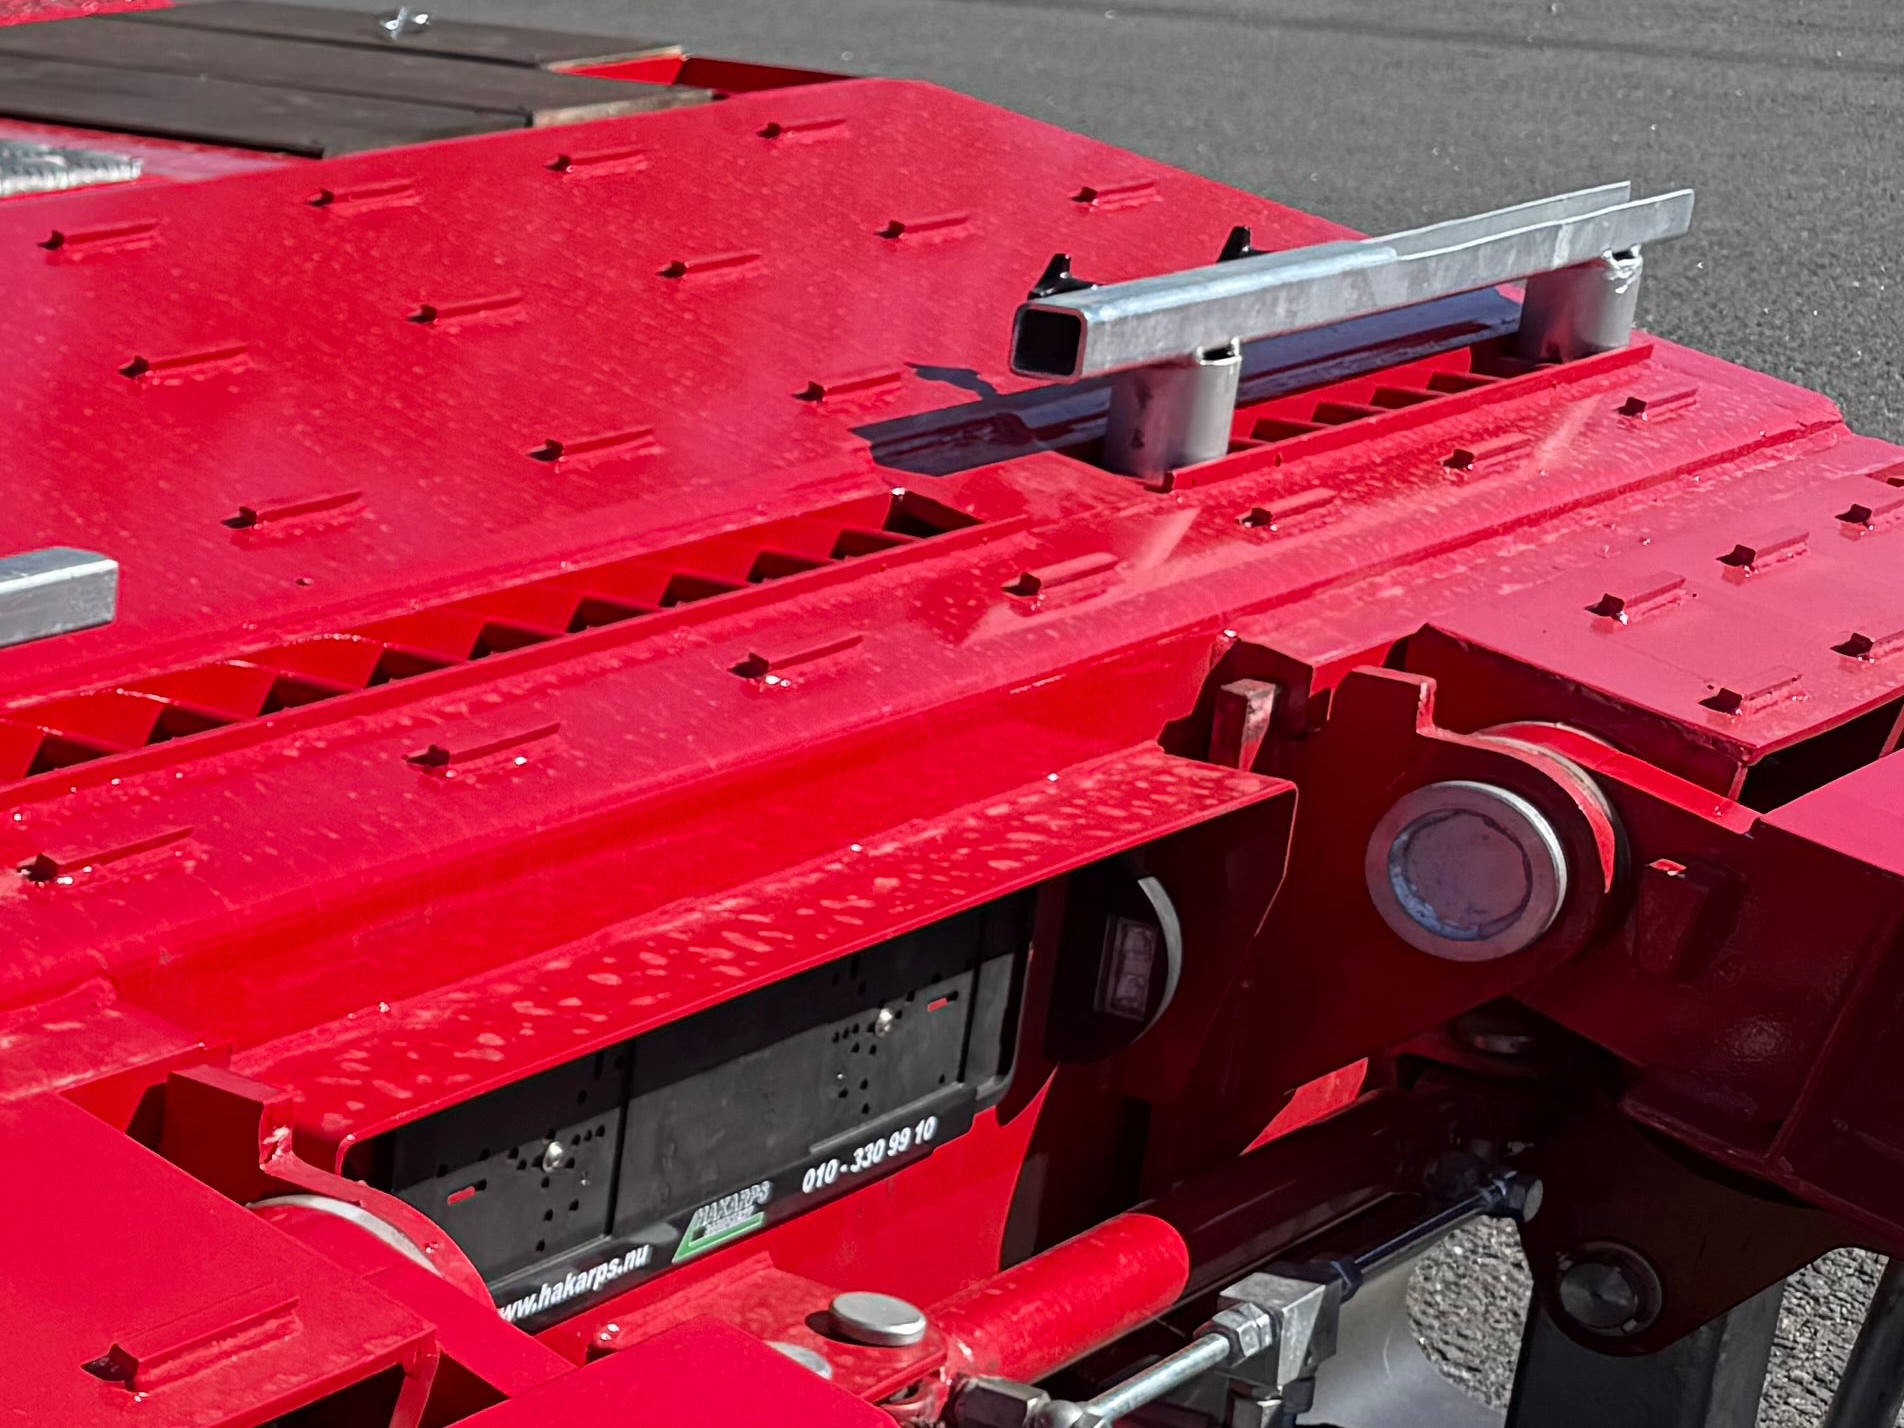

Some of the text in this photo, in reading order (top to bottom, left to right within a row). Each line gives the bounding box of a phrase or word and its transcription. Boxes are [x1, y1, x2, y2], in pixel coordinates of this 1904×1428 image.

[802, 1158, 840, 1194] 010
[850, 1138, 886, 1173] 330
[887, 1126, 911, 1157] 99
[915, 1115, 938, 1145] 10
[497, 1243, 652, 1322] ww.hakarps.nu
